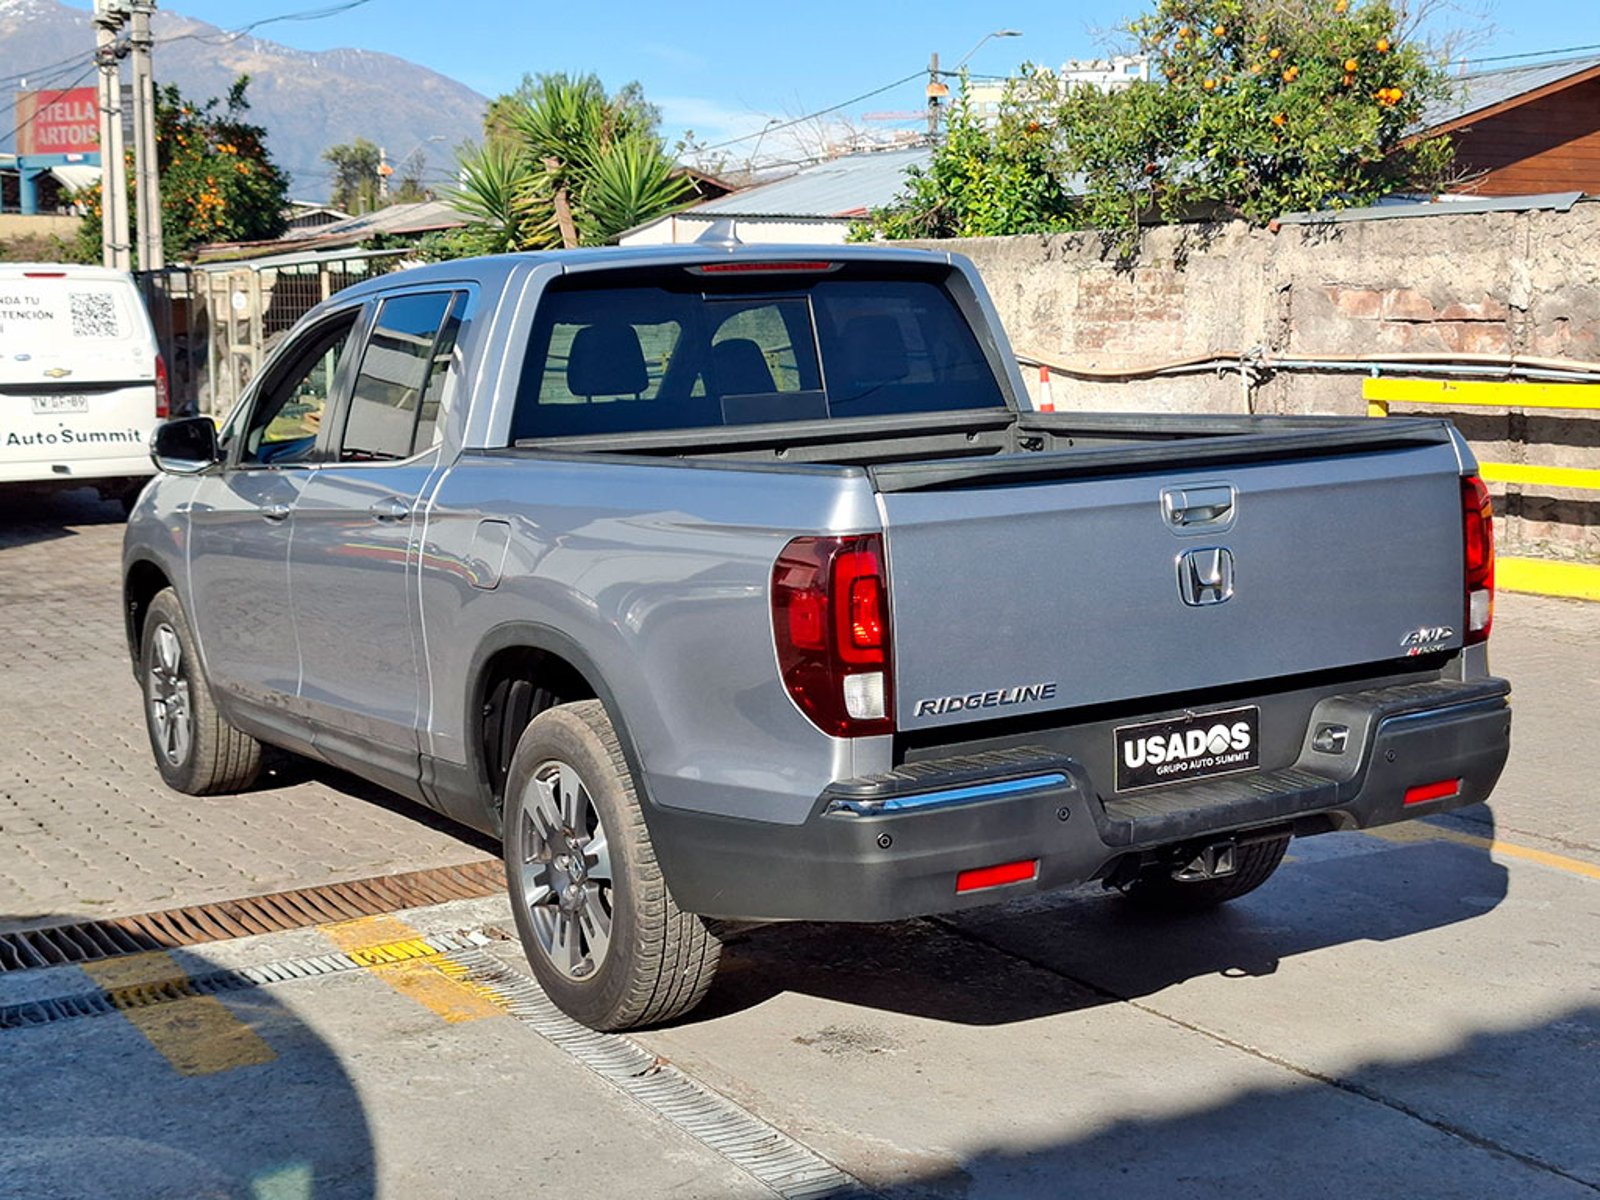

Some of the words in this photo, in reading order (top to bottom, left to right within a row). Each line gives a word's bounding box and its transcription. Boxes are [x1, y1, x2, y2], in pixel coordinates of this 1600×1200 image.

[35, 101, 96, 123] STELLA
[38, 124, 98, 146] ARTOIS
[25, 296, 40, 305] TU
[0, 309, 54, 320] TENCIÓN
[913, 682, 1057, 717] RIDGELINE
[1124, 722, 1251, 768] USADOS
[1156, 762, 1188, 775] GRUPO
[1189, 758, 1214, 770] AUTO
[1215, 751, 1250, 765] SUMMIT
